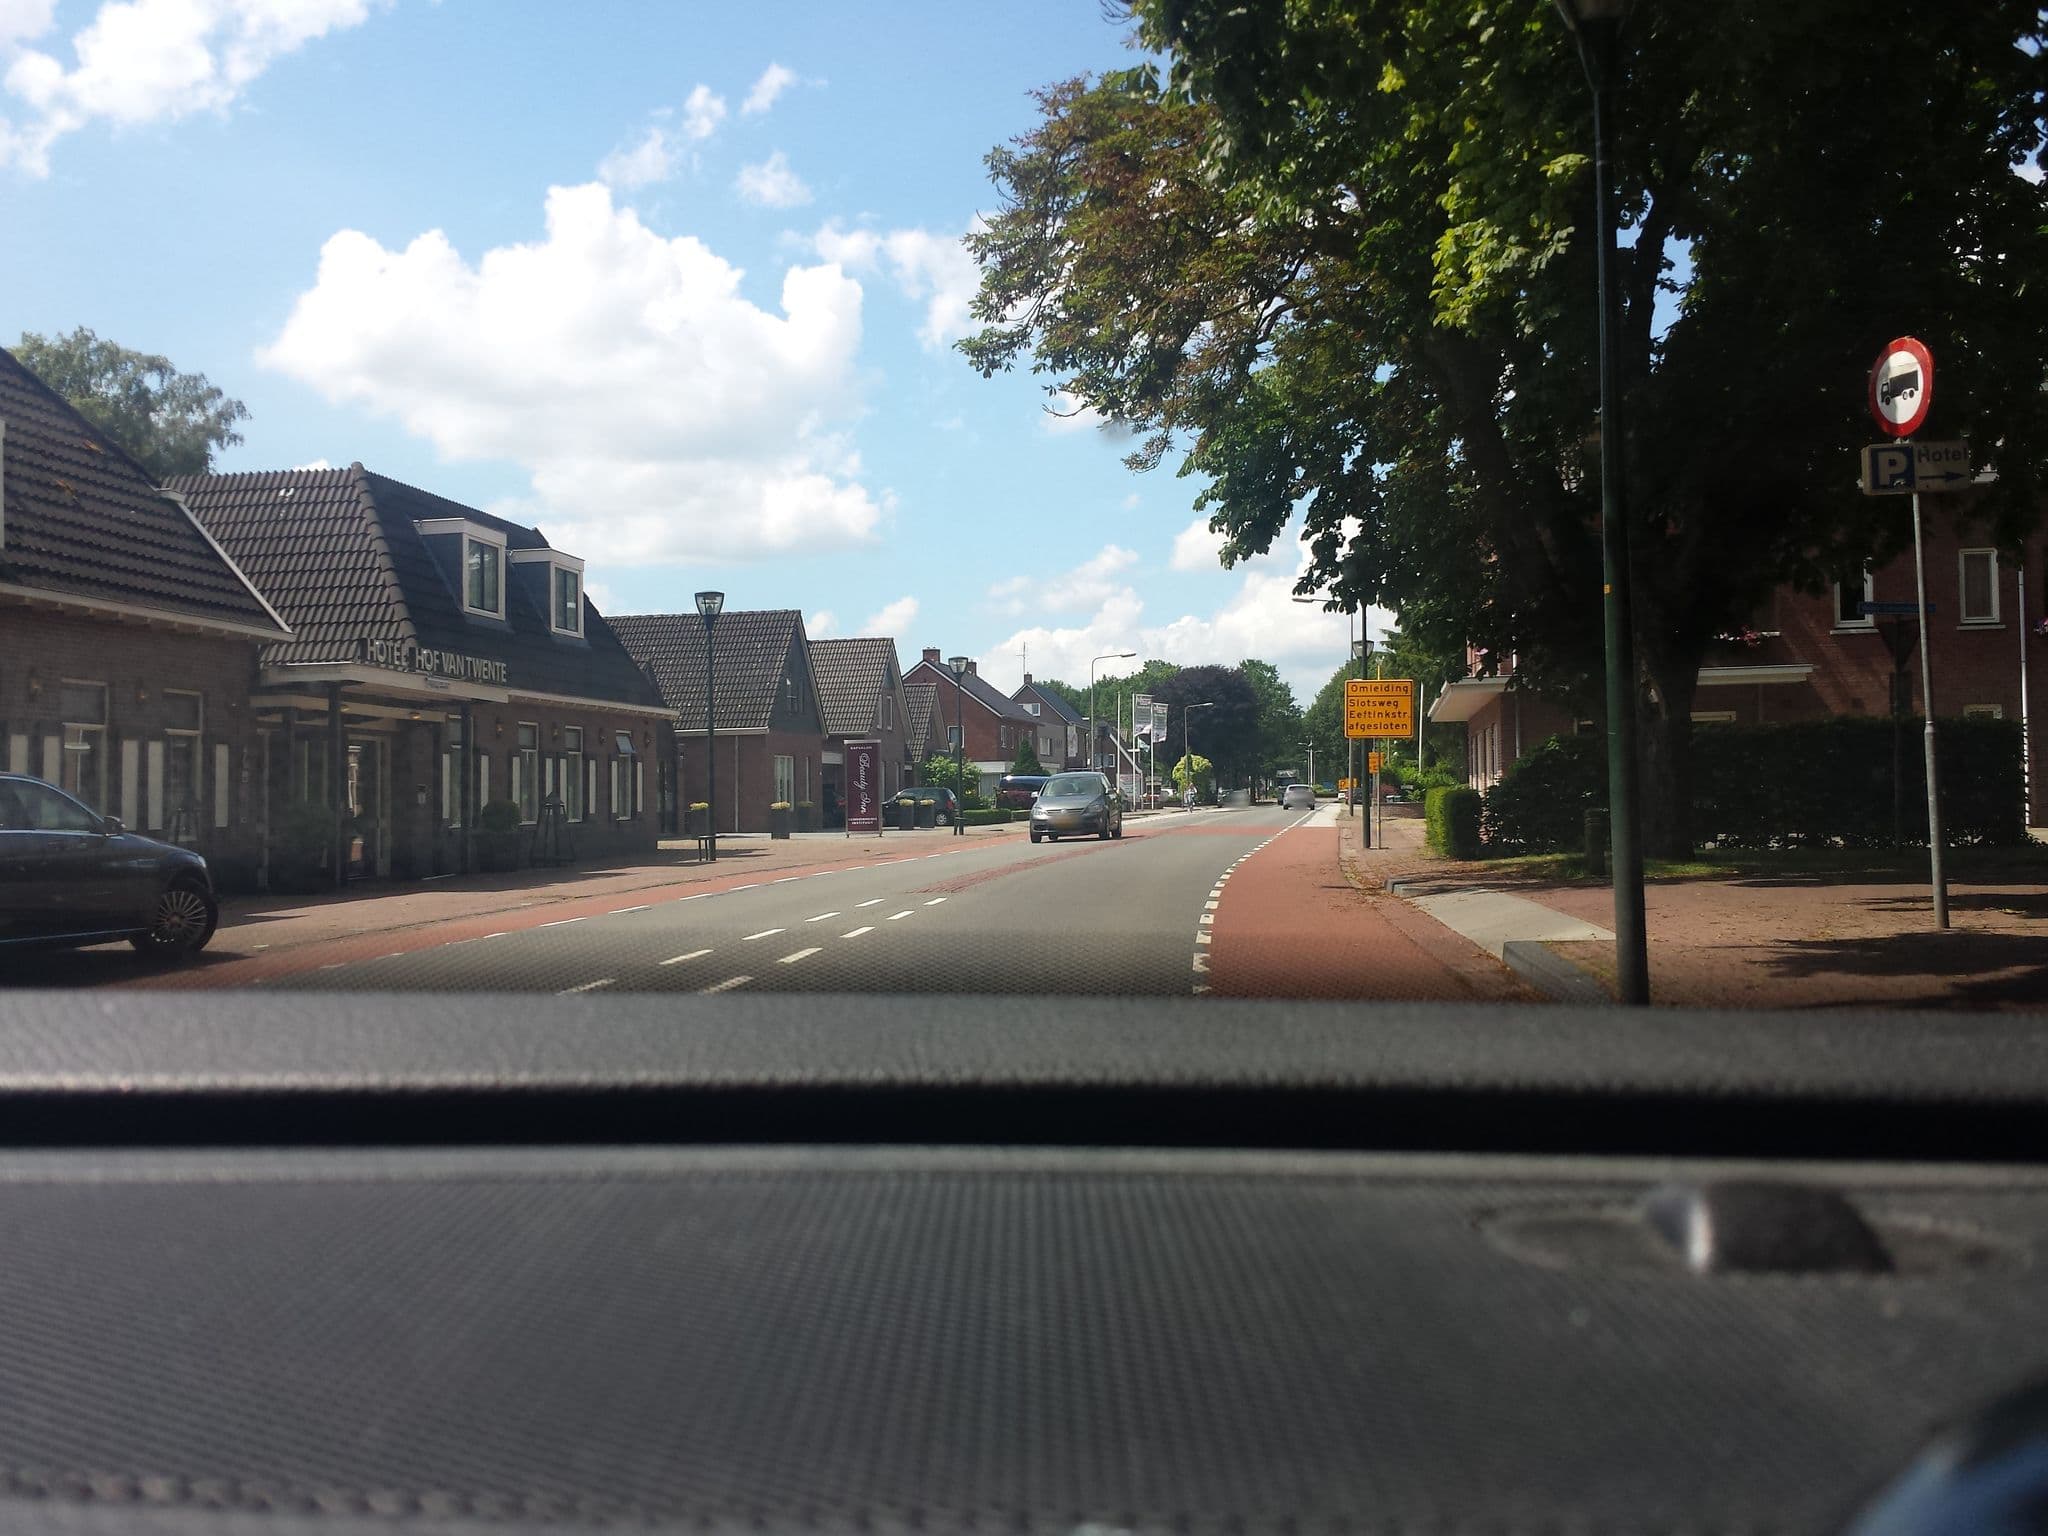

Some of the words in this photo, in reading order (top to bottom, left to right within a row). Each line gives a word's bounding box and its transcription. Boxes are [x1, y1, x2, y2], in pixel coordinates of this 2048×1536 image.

[1878, 451, 1907, 487] P
[1917, 447, 1967, 463] Hotel
[367, 637, 408, 666] HOTEL
[415, 648, 440, 671] HOF
[441, 652, 465, 675] VAN
[466, 656, 507, 683] TWENTE
[1351, 684, 1409, 694] Omleiding
[1349, 699, 1399, 709] Slotsweg
[1348, 722, 1408, 732] afgesloten
[853, 752, 871, 790] Beauty
